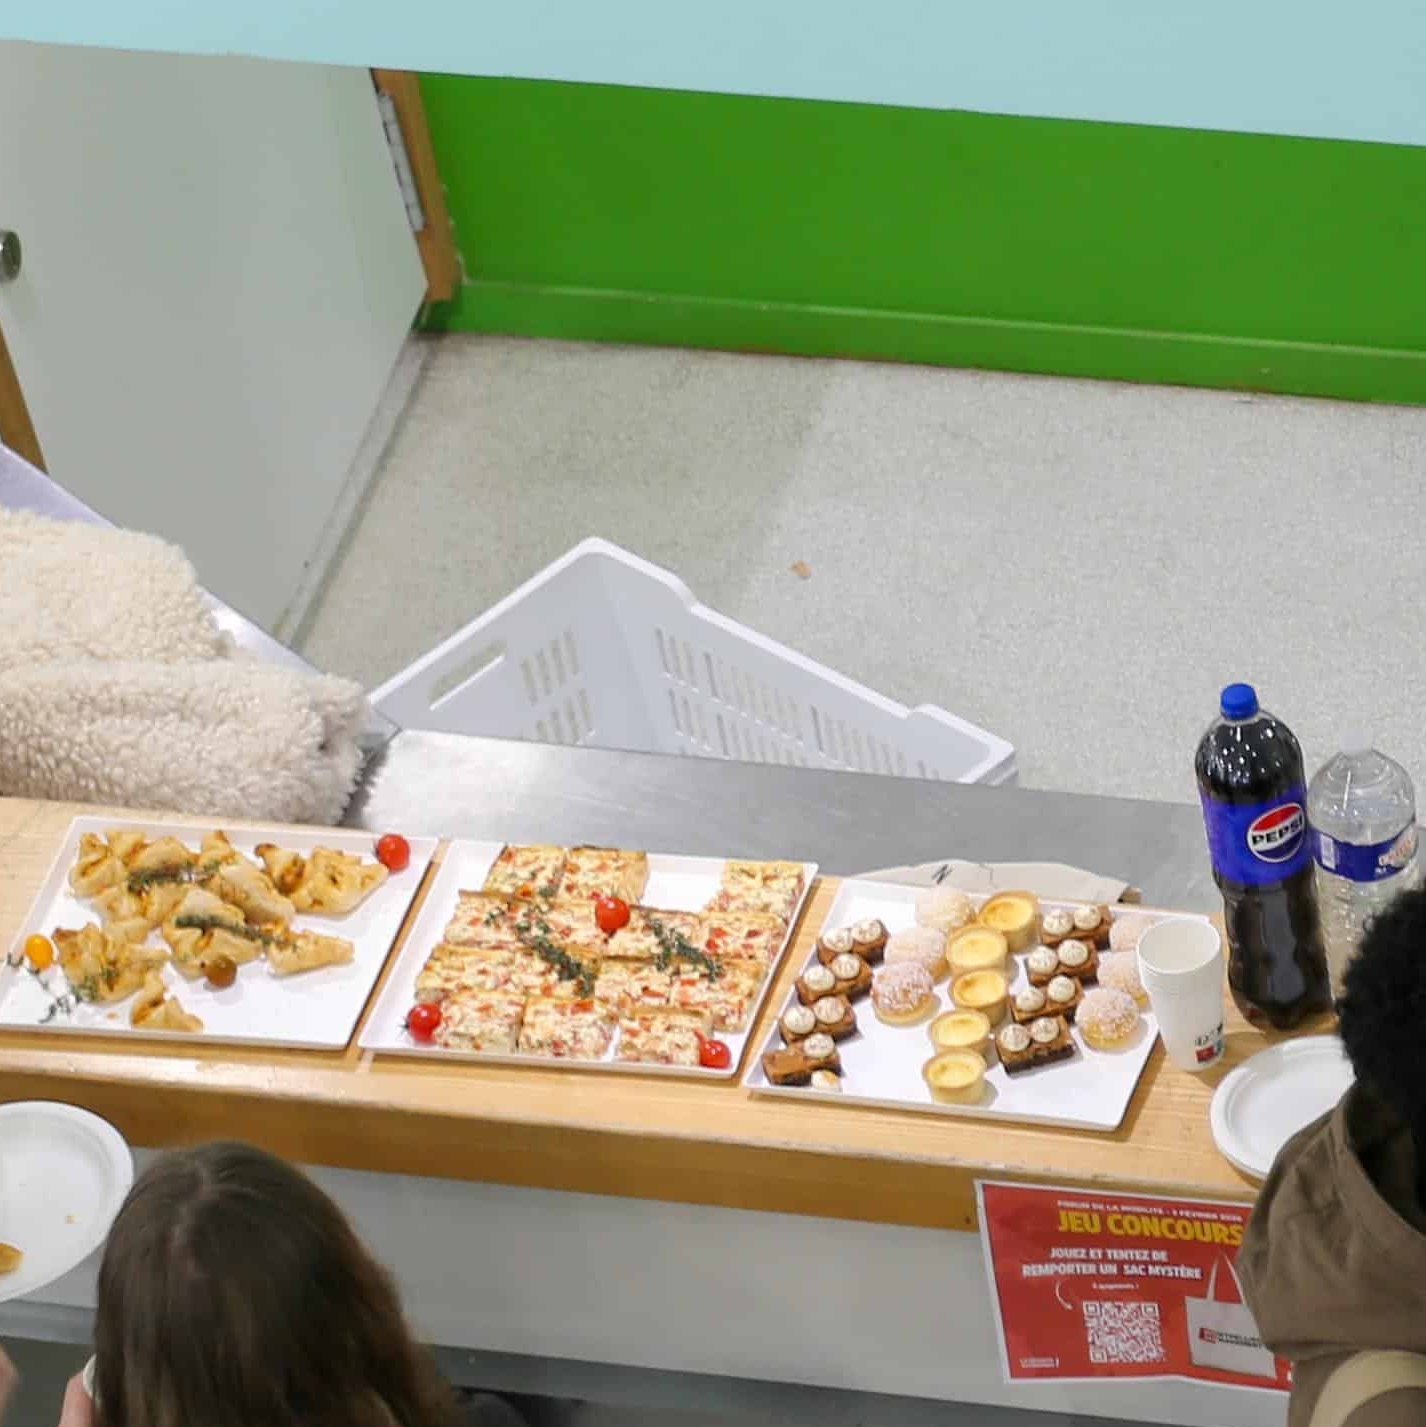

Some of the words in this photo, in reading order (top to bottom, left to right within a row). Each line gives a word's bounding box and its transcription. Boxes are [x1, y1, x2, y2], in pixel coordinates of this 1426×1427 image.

[1252, 814, 1303, 845] PEPSI
[1058, 1211, 1102, 1233] JEU
[1106, 1213, 1244, 1246] CONCOURS
[1050, 1248, 1087, 1259] JOUEZ
[1089, 1248, 1103, 1259] ET
[1106, 1249, 1149, 1261] TENTEZ
[1152, 1251, 1169, 1262] DE
[1022, 1264, 1097, 1278] REMPORTER
[1099, 1264, 1119, 1275] UN
[1123, 1265, 1147, 1276] SAC
[1148, 1263, 1203, 1280] MYSTÈRE
